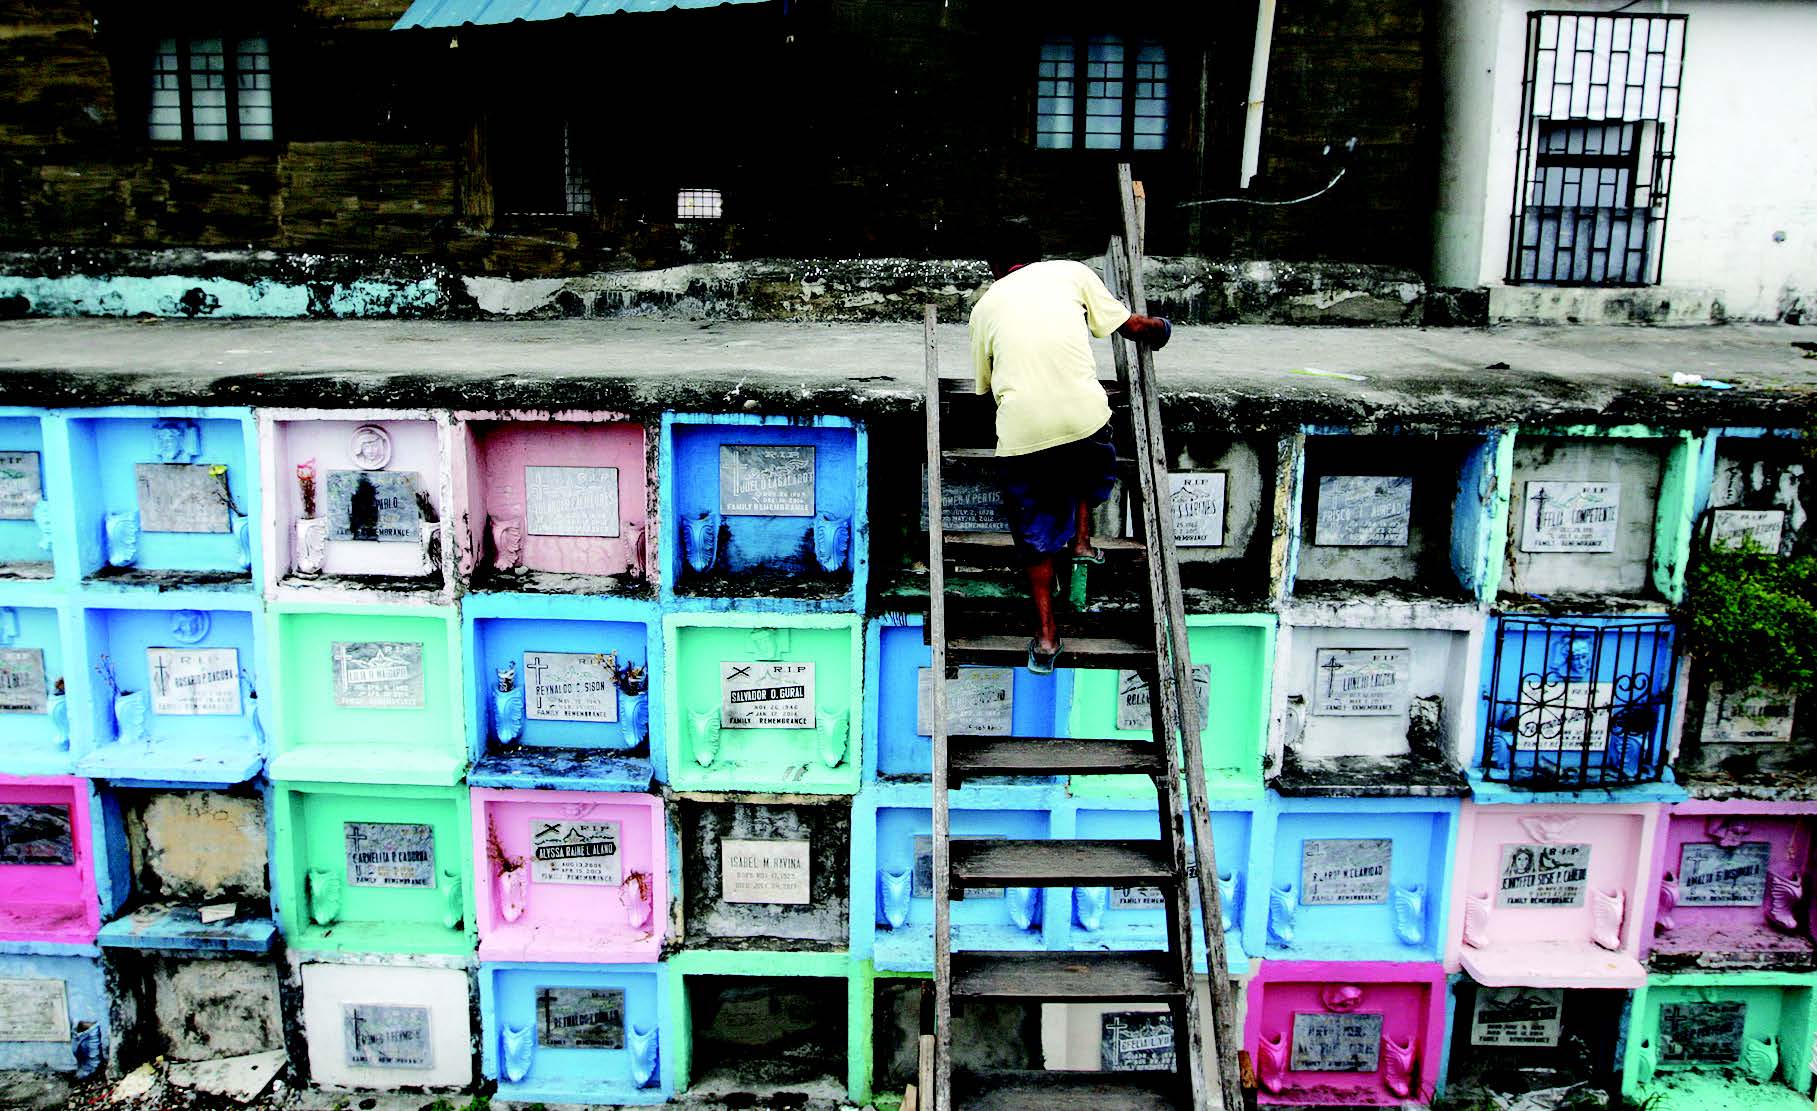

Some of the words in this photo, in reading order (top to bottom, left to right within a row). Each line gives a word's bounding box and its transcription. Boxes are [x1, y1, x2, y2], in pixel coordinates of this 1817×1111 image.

[727, 503, 753, 511] FAMILY
[584, 681, 605, 692] SISON
[731, 688, 767, 703] SALVADOR
[779, 686, 804, 699] GURAL
[729, 717, 751, 725] FAMILY
[759, 717, 808, 725] REMEMBRANCE
[539, 845, 564, 859] ALYSSA
[592, 843, 613, 855] ALANO
[730, 856, 758, 868] ISABEL
[774, 856, 801, 869] RAVINA
[384, 877, 427, 885] REMEMBRANCE
